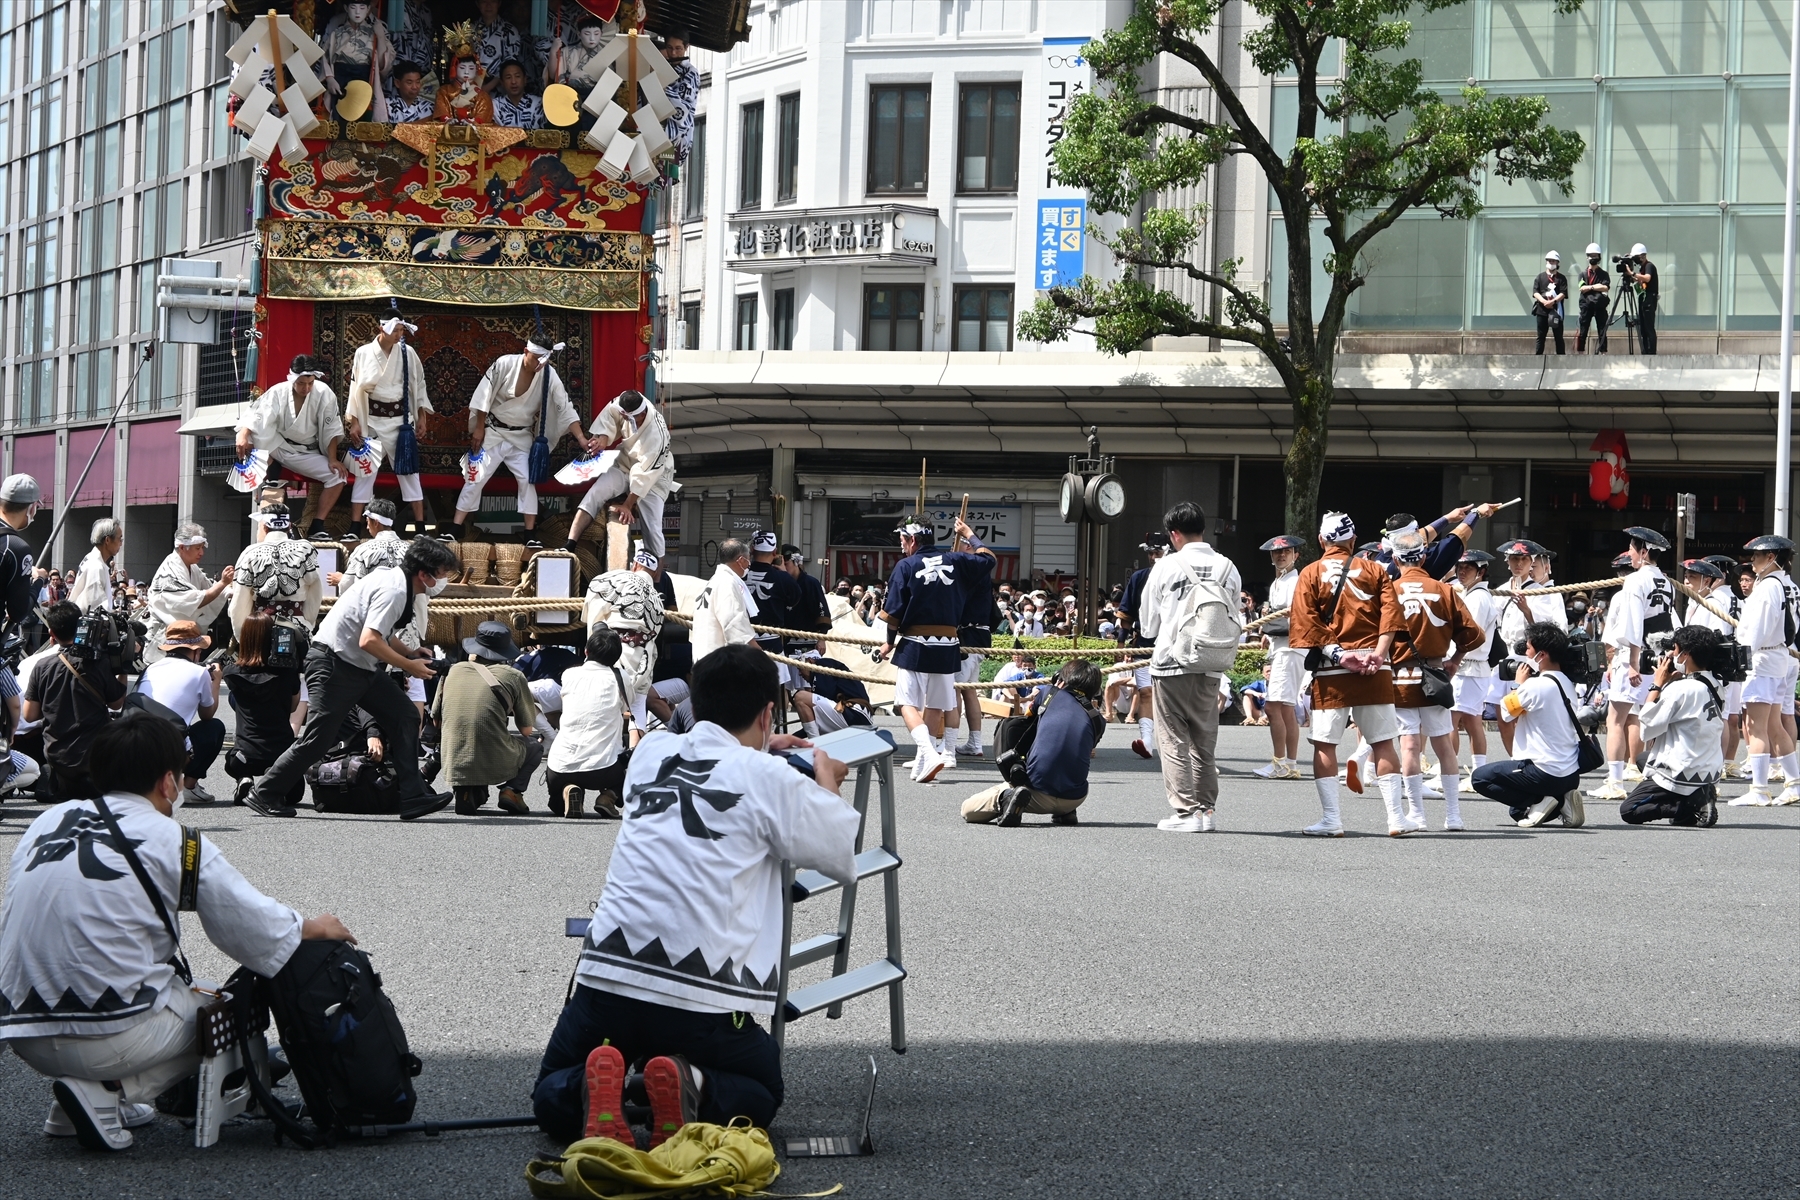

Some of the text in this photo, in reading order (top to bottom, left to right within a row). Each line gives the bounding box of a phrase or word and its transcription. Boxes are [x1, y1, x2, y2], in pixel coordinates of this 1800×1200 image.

[734, 218, 882, 255] 池善化粧品店
[1063, 209, 1079, 250] すぐ
[1040, 207, 1059, 287] 買えます
[733, 521, 762, 529] コンタクト
[948, 511, 1007, 520] メネスーパー
[185, 839, 196, 871] Nikon
